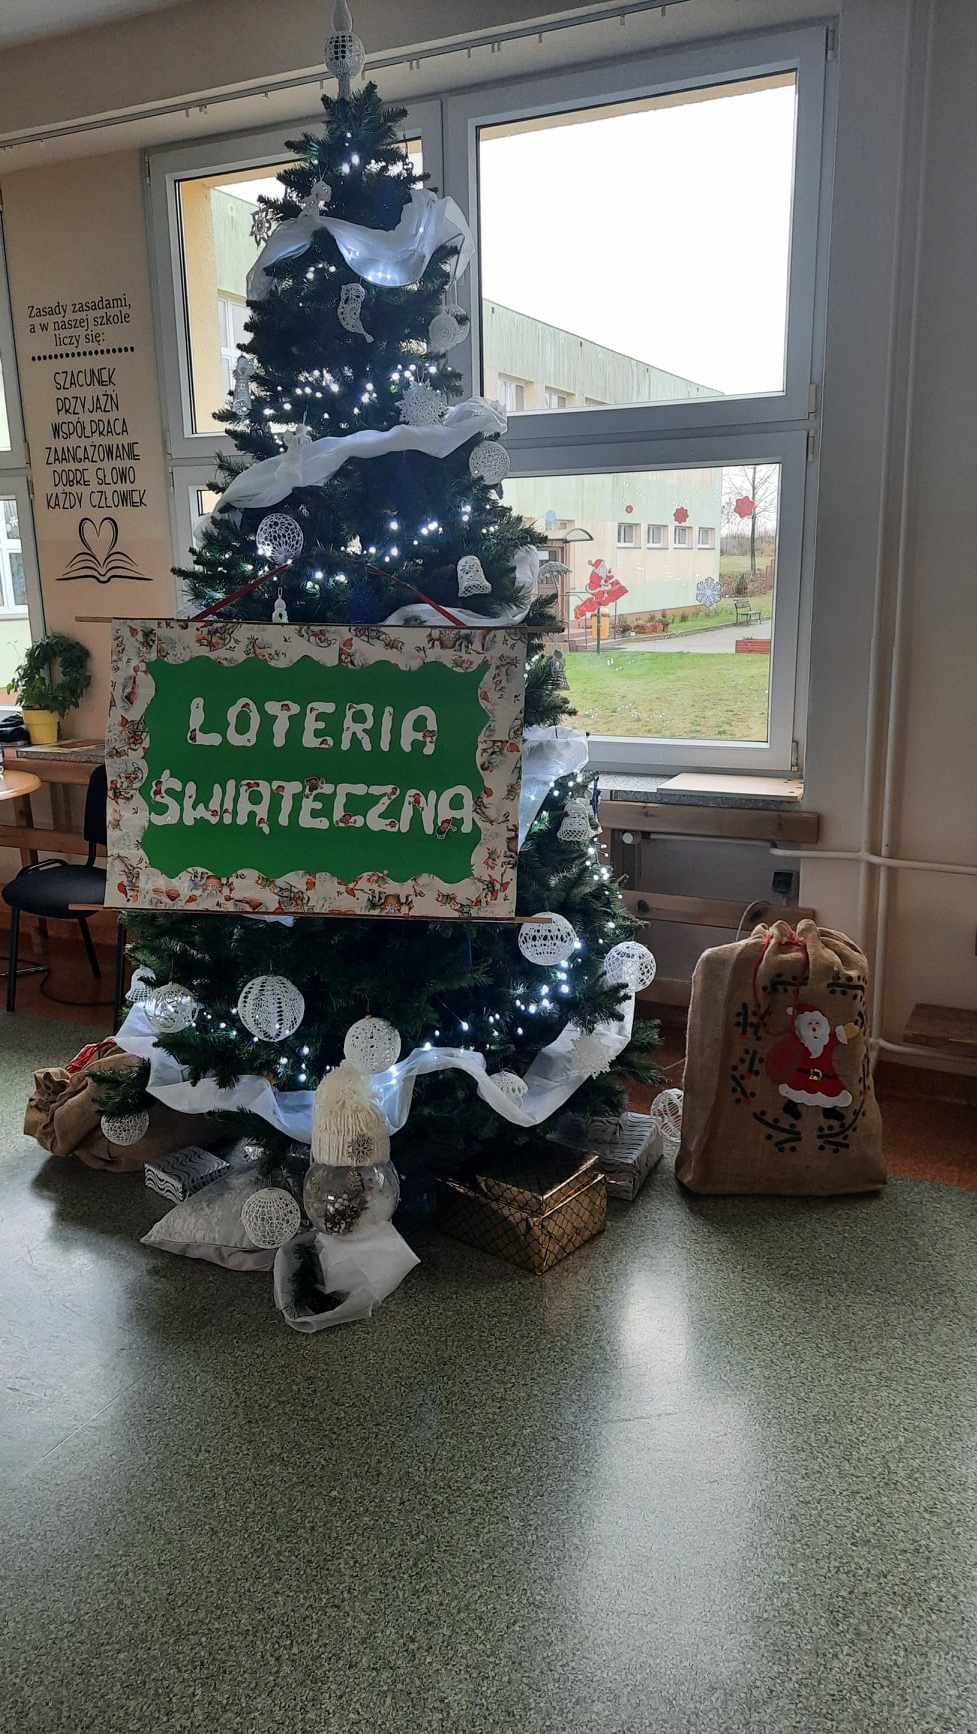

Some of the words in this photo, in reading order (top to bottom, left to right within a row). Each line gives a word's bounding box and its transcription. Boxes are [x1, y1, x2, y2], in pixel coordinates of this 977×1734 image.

[27, 301, 67, 319] Zasady
[71, 293, 131, 314] zasadami,
[29, 323, 36, 334] a
[39, 322, 49, 333] w
[53, 314, 90, 332] naszej
[93, 310, 131, 327] szkole
[54, 333, 80, 348] liczy
[84, 330, 105, 346] się:
[53, 367, 116, 391] SZACUNEK
[56, 389, 119, 416] PRZYJAŹŃ
[51, 417, 129, 440] WSPÓŁPRACA
[45, 441, 141, 465] ZAANGAŻOWANIE
[52, 468, 91, 488] DOBRE
[95, 466, 136, 486] SŁOWO
[45, 488, 83, 510] KAŻDY
[89, 488, 147, 509] CZŁOWIEK
[187, 696, 439, 755] LOTERIA
[149, 769, 475, 840] ŚWIĄTECZNA
